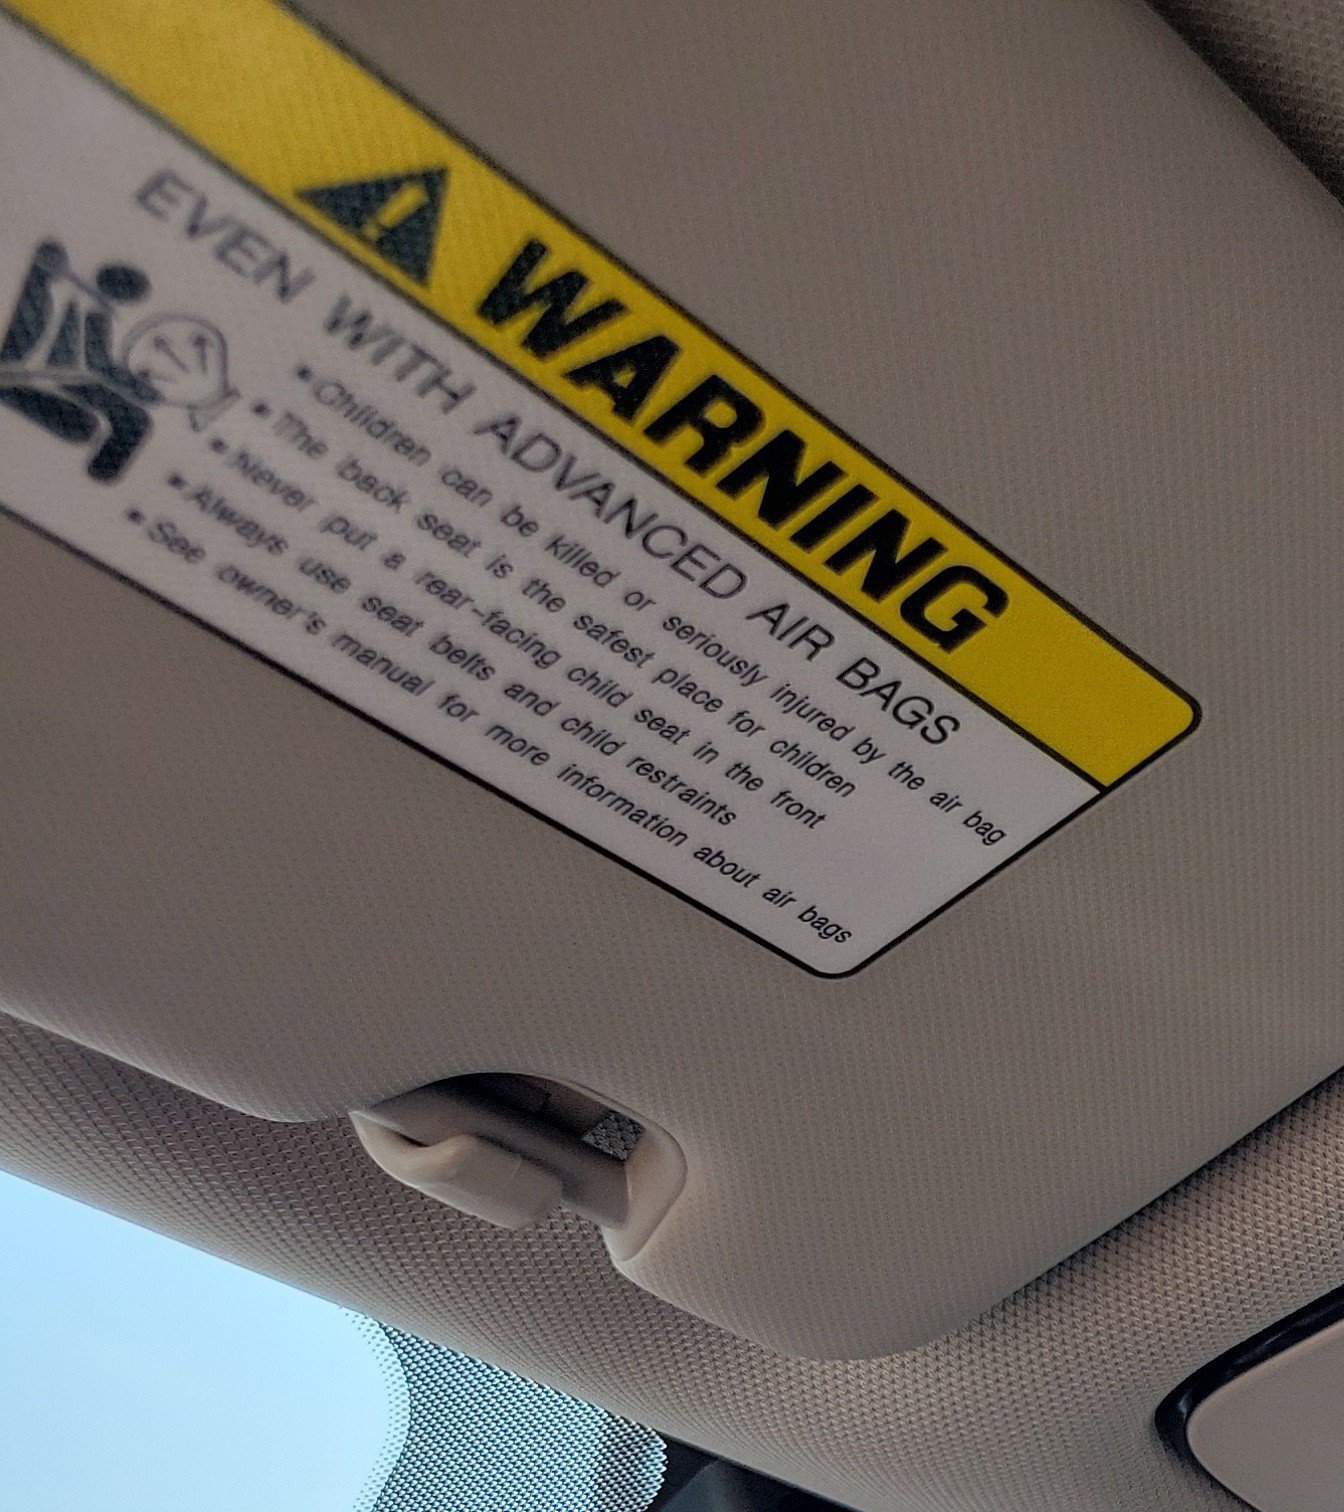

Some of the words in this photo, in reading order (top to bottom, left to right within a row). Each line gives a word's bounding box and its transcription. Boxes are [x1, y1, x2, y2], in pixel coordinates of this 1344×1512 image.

[136, 169, 316, 301] EVEN
[325, 297, 477, 414] WITH
[472, 414, 747, 598] ADVANCED
[746, 603, 835, 662] AIR
[836, 657, 960, 745] BAGS
[234, 450, 316, 510] Never
[319, 514, 378, 550] put
[382, 551, 406, 571] a
[414, 572, 562, 669] rear-facing
[567, 666, 633, 708] child
[634, 707, 691, 745] seat
[692, 741, 719, 764] in
[725, 762, 764, 792] the
[771, 790, 827, 829] front
[273, 411, 328, 459] The
[336, 457, 410, 511] back
[416, 512, 481, 557] seat
[486, 553, 513, 579] is
[522, 577, 566, 613] the
[573, 613, 655, 669] safest
[652, 668, 723, 713] place
[727, 711, 766, 738] for
[770, 738, 856, 797] children
[314, 380, 430, 467] Children
[439, 467, 493, 507] can
[501, 505, 540, 537] be
[545, 534, 621, 588] killed
[623, 591, 657, 611] or
[663, 614, 769, 687] seriously
[770, 684, 855, 741] injured
[852, 737, 886, 764] by
[888, 761, 925, 790] the
[929, 791, 963, 813] air
[963, 811, 1007, 846] bag
[475, 239, 1008, 653] WARNING
[148, 519, 205, 563] See
[216, 564, 327, 635] owner's
[332, 632, 436, 697] manual
[437, 694, 480, 722] for
[484, 724, 551, 766] more
[557, 763, 689, 847] information
[693, 847, 761, 888] about
[762, 886, 797, 907] air
[797, 906, 853, 944] bags
[189, 486, 288, 555] Always
[299, 558, 351, 593] use
[360, 595, 425, 638] seat
[429, 634, 496, 681] belts
[504, 682, 561, 716] and
[561, 716, 626, 757] child
[626, 754, 737, 826] restraints
